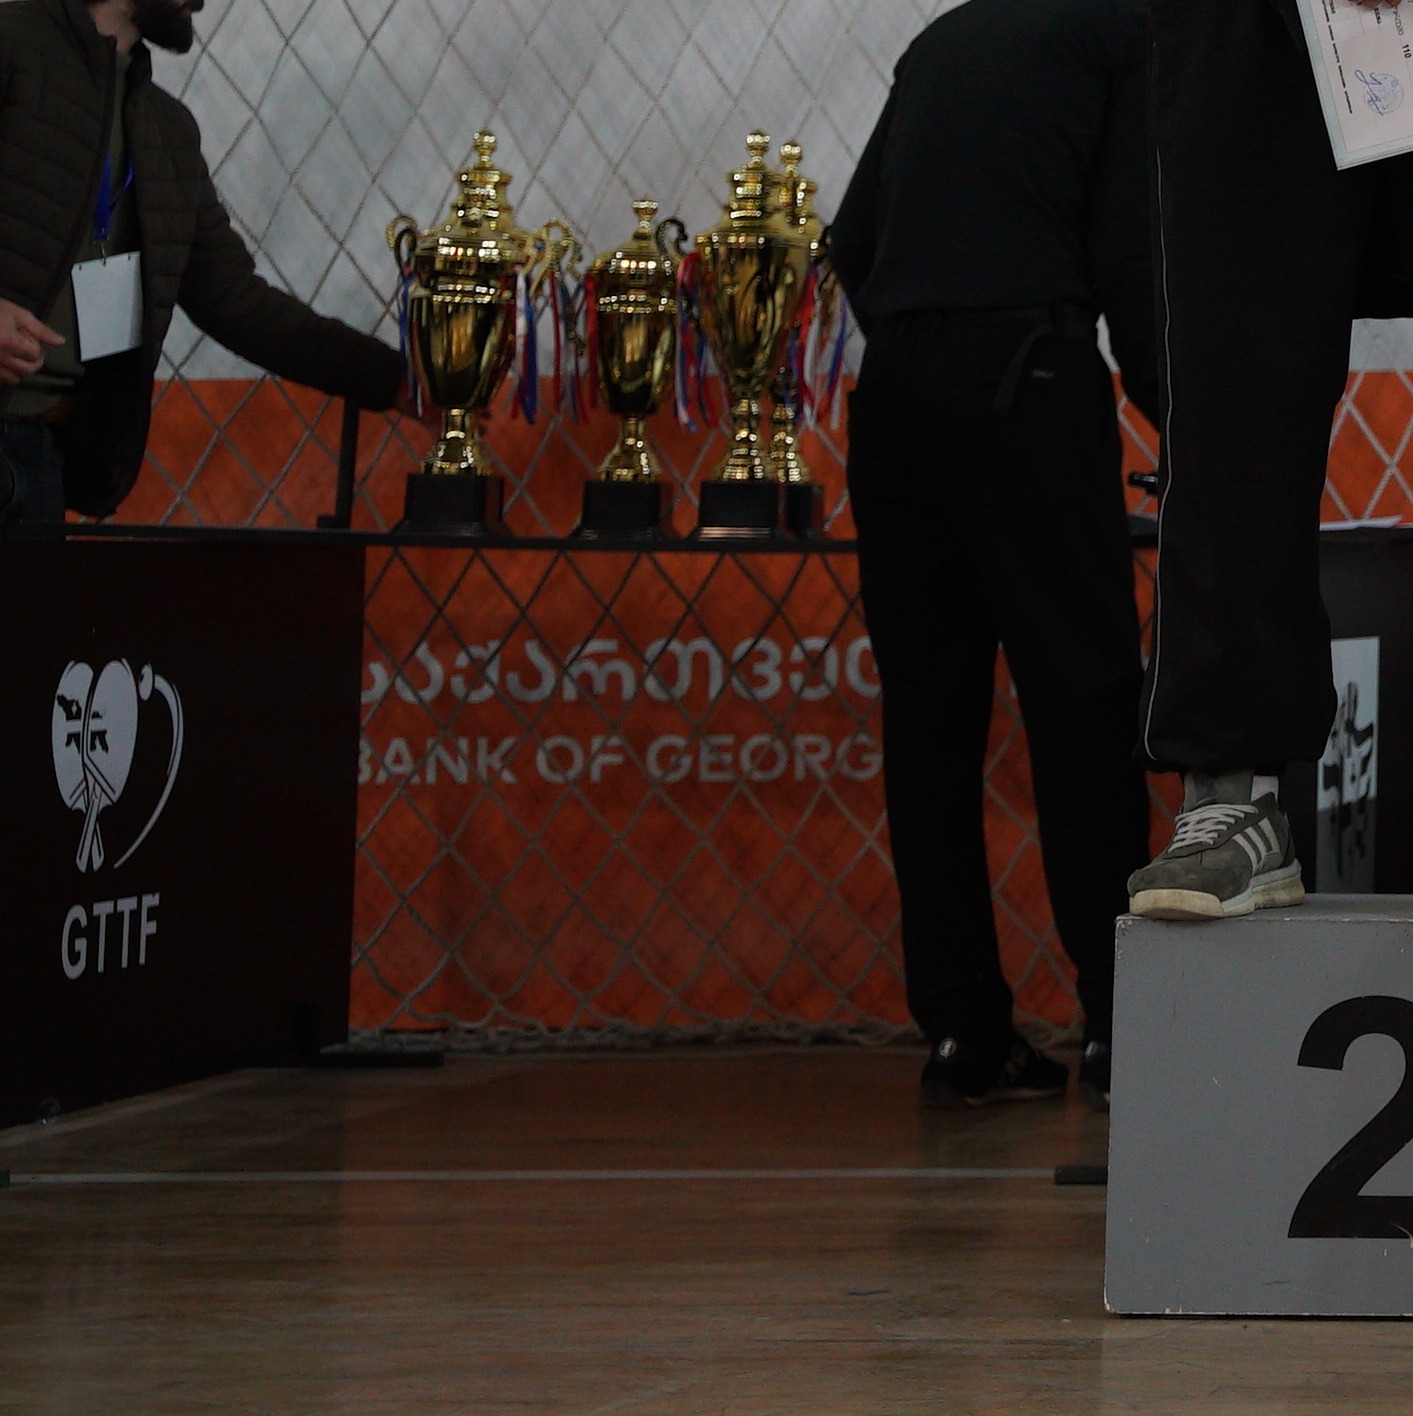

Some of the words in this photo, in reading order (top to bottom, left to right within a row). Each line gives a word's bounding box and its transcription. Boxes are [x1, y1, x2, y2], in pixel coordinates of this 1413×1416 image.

[534, 734, 625, 785] OF
[645, 733, 884, 784] GEORG
[61, 890, 161, 981] GTTF
